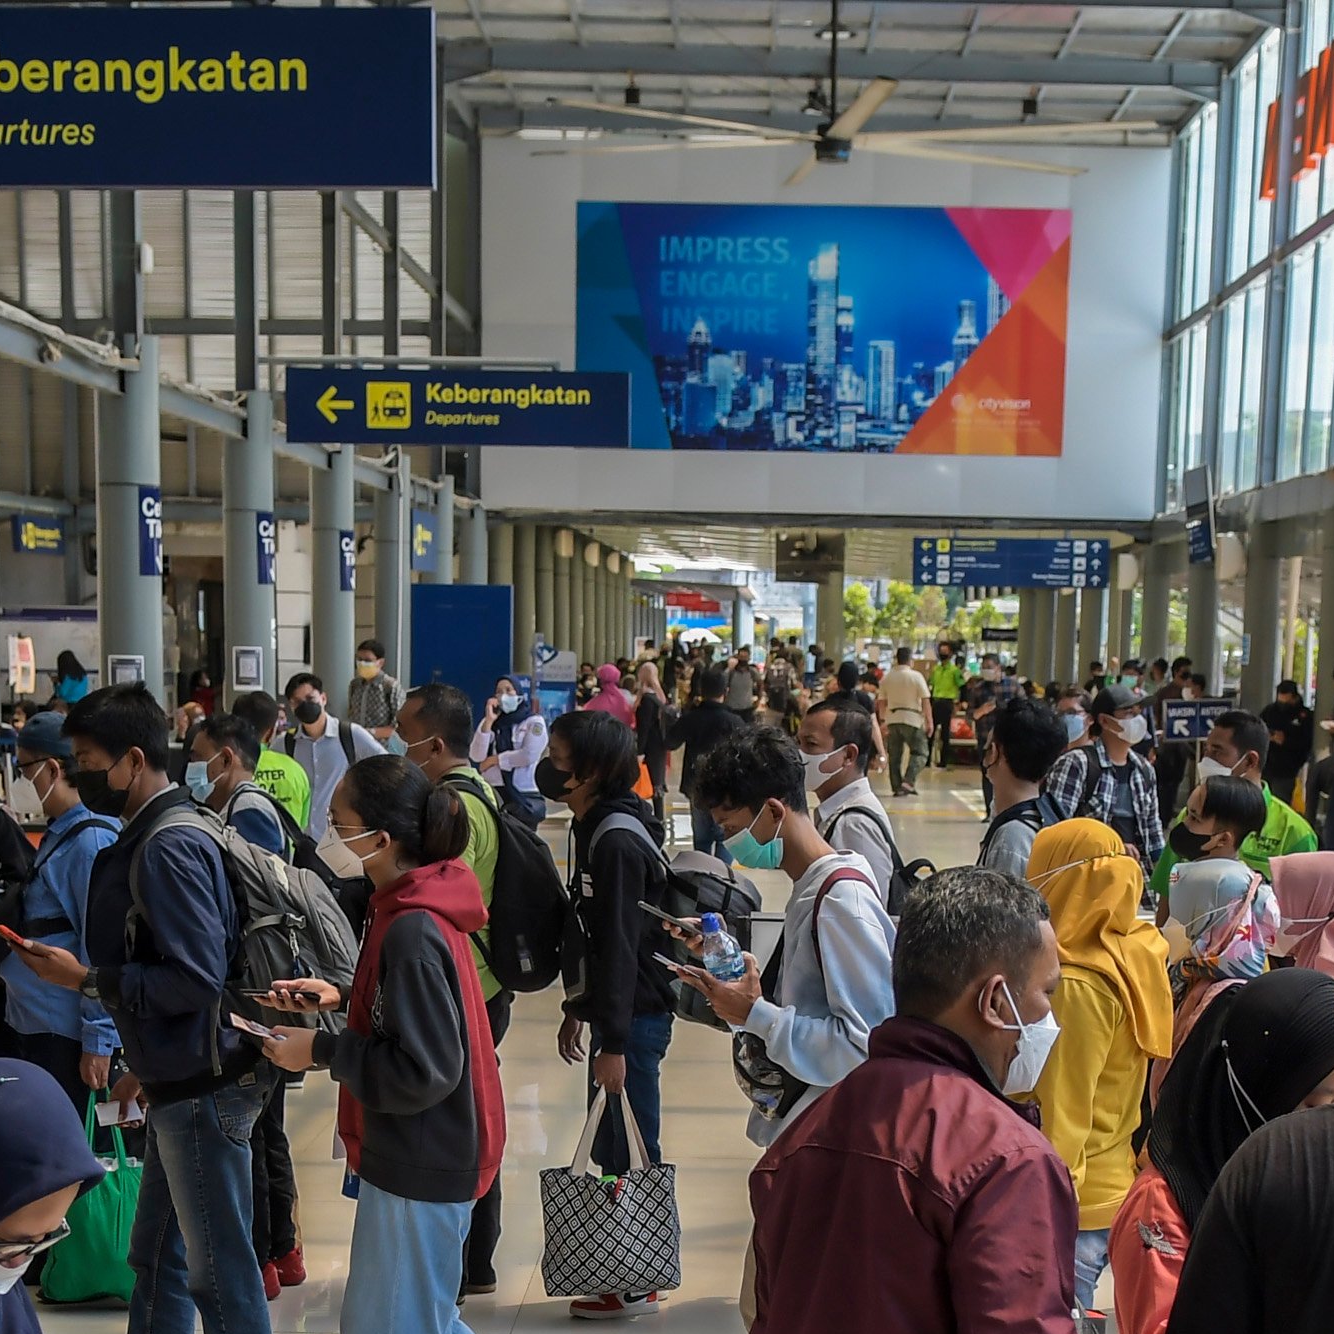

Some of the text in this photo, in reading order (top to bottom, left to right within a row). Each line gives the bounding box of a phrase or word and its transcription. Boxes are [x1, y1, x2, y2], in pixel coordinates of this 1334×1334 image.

[426, 383, 590, 409] Keberangkatan
[425, 411, 500, 427] Departures
[254, 770, 285, 782] RTER
